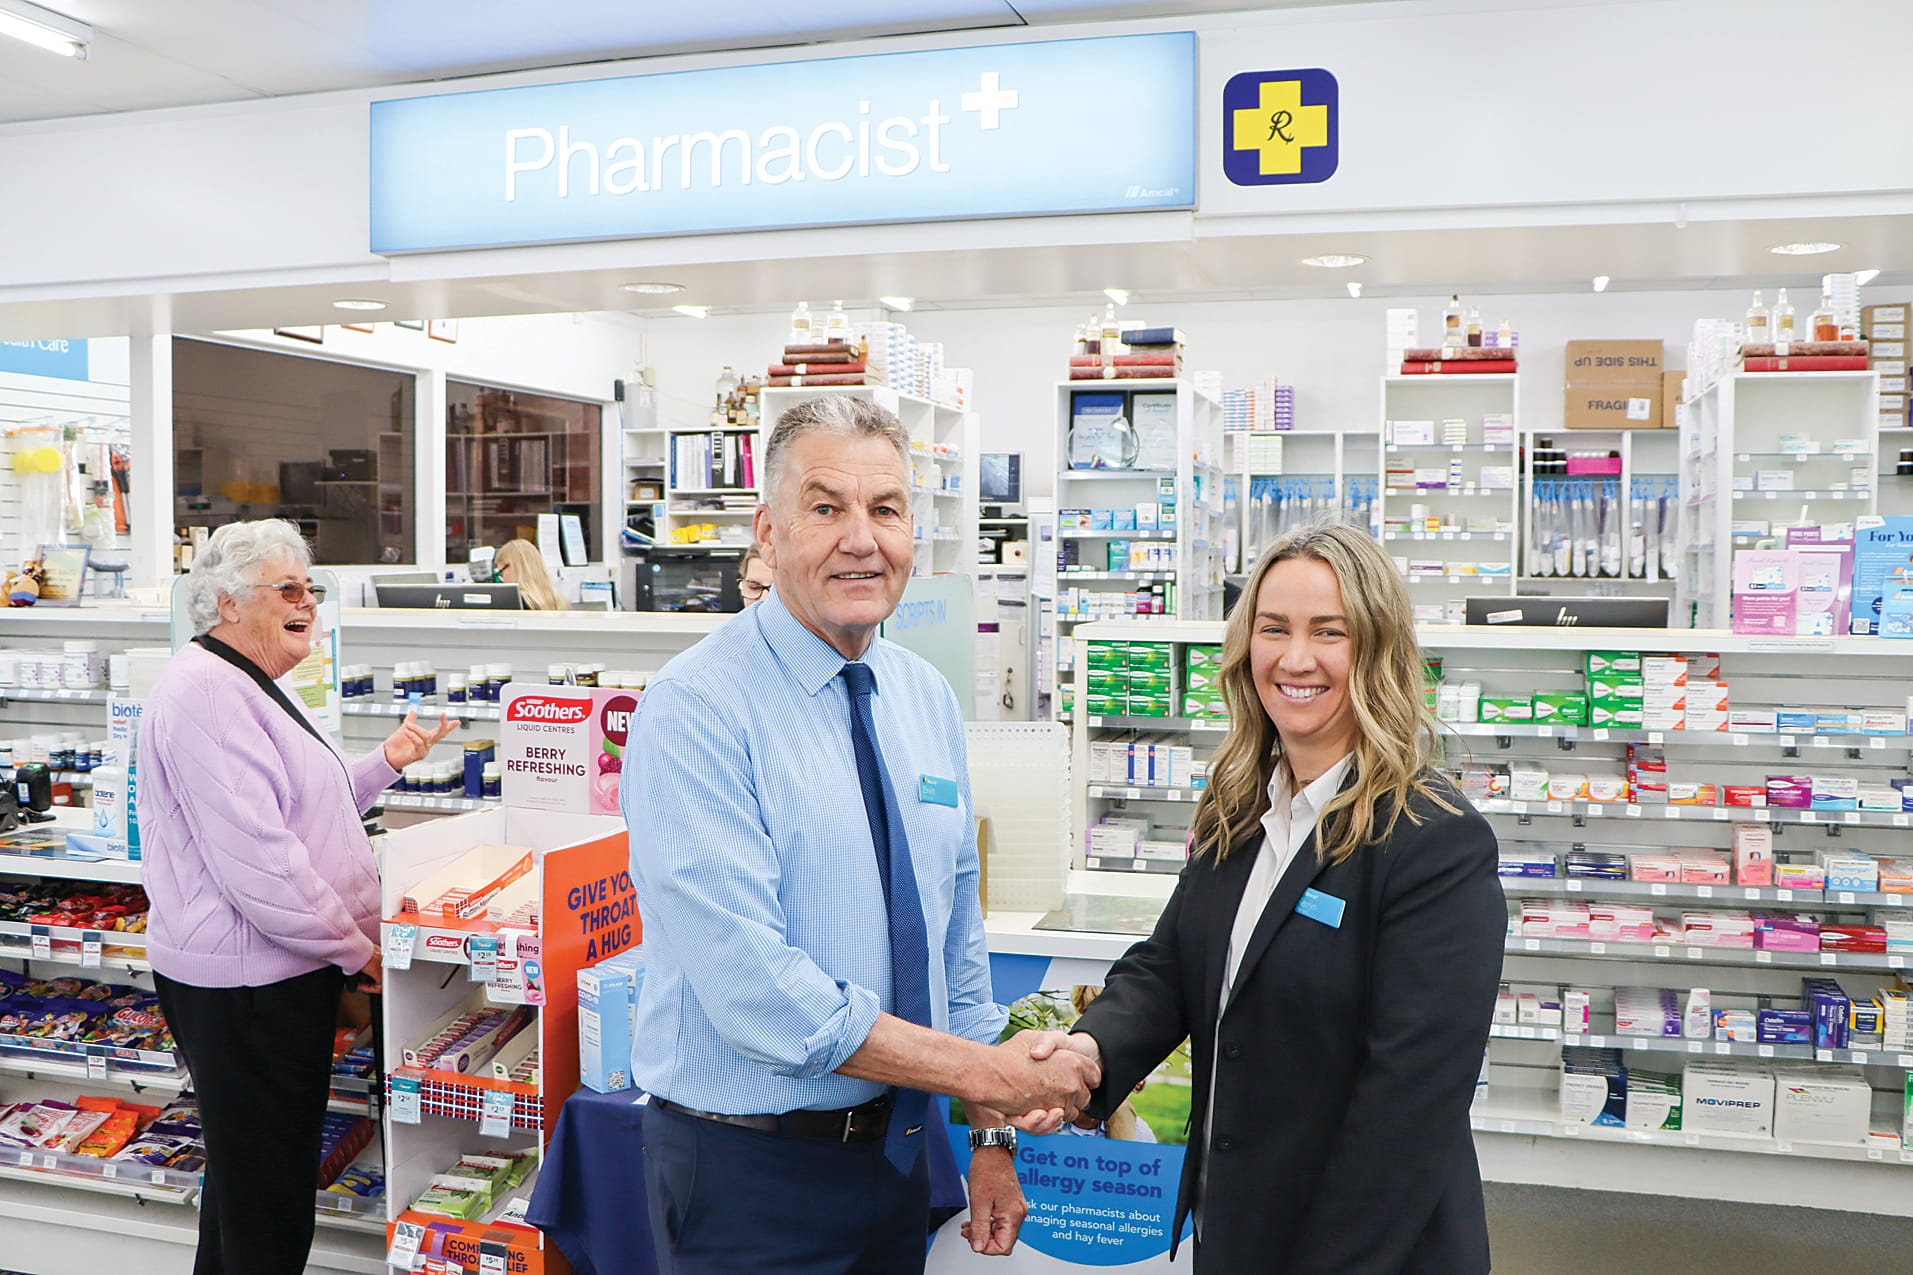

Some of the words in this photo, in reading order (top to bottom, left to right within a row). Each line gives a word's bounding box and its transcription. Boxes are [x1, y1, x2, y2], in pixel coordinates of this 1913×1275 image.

[506, 100, 951, 201] Pharmacist
[1574, 357, 1592, 367] UP
[1595, 357, 1624, 367] SIDE
[1628, 357, 1656, 367] THIS
[1870, 530, 1895, 542] For
[436, 594, 451, 608] hp
[1556, 606, 1578, 627] hp
[517, 723, 541, 731] LIQUID
[543, 725, 576, 734] CENTRES
[526, 747, 566, 760] BERRY
[507, 760, 586, 776] REFRESHING
[568, 878, 607, 910] GIVE
[580, 894, 636, 935] THROAT
[586, 938, 597, 962] A
[601, 924, 631, 955] HUG
[1696, 1098, 1761, 1109] MOVIPREP
[1020, 1147, 1057, 1166] Get
[1064, 1156, 1089, 1170] on
[1095, 1156, 1131, 1178] top
[1139, 1158, 1162, 1176] of
[1018, 1168, 1085, 1195] allergy
[1092, 1178, 1162, 1198] season
[1026, 1199, 1037, 1210] sk
[1041, 1202, 1058, 1212] our
[1061, 1203, 1125, 1219] pharmacists
[1129, 1210, 1161, 1223] about
[1024, 1214, 1067, 1228] anaging
[1069, 1217, 1115, 1231] seasonal
[1118, 1222, 1163, 1237] allergies
[1052, 1229, 1072, 1241] and
[1075, 1232, 1093, 1245] hay
[1096, 1234, 1124, 1246] fever
